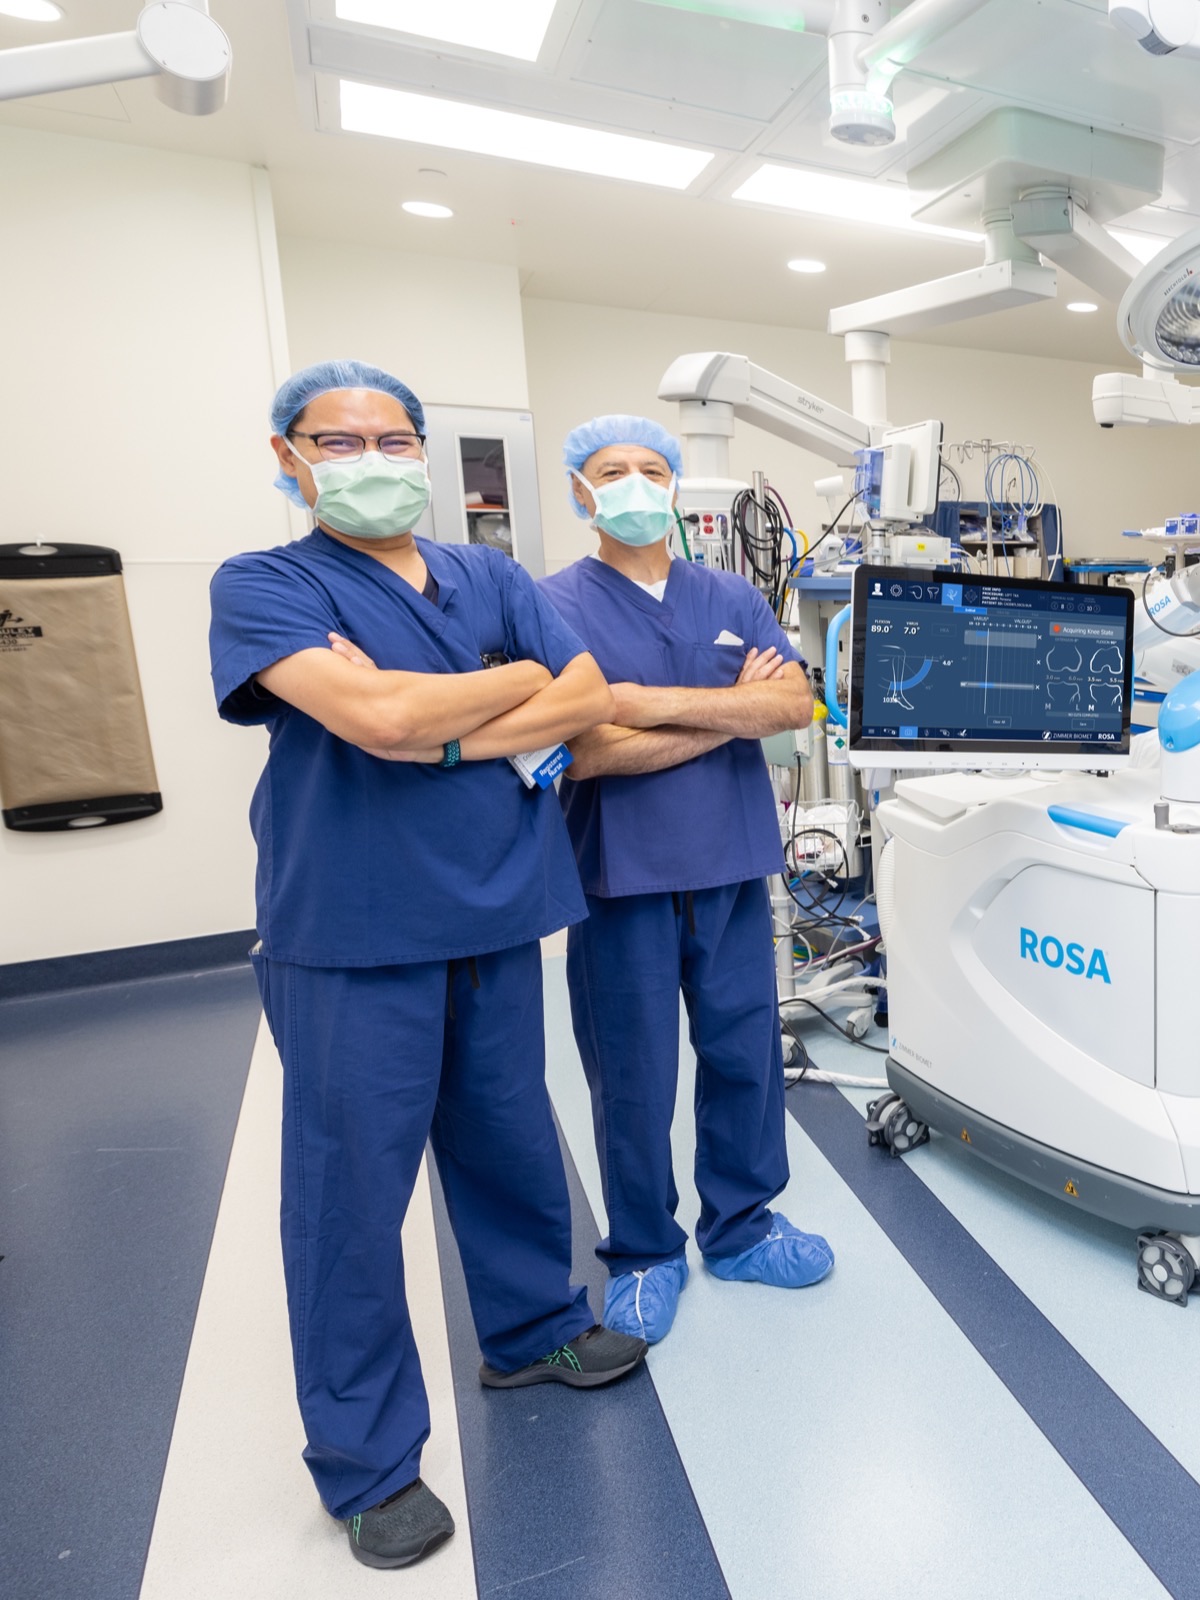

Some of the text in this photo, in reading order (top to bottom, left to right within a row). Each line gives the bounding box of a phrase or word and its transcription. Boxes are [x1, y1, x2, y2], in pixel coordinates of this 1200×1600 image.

[797, 396, 824, 414] stryker
[1148, 595, 1171, 616] ROSA
[1063, 627, 1086, 636] Acquiring
[539, 751, 563, 777] Registered
[548, 763, 563, 778] Nurse
[1020, 926, 1112, 984] ROSA
